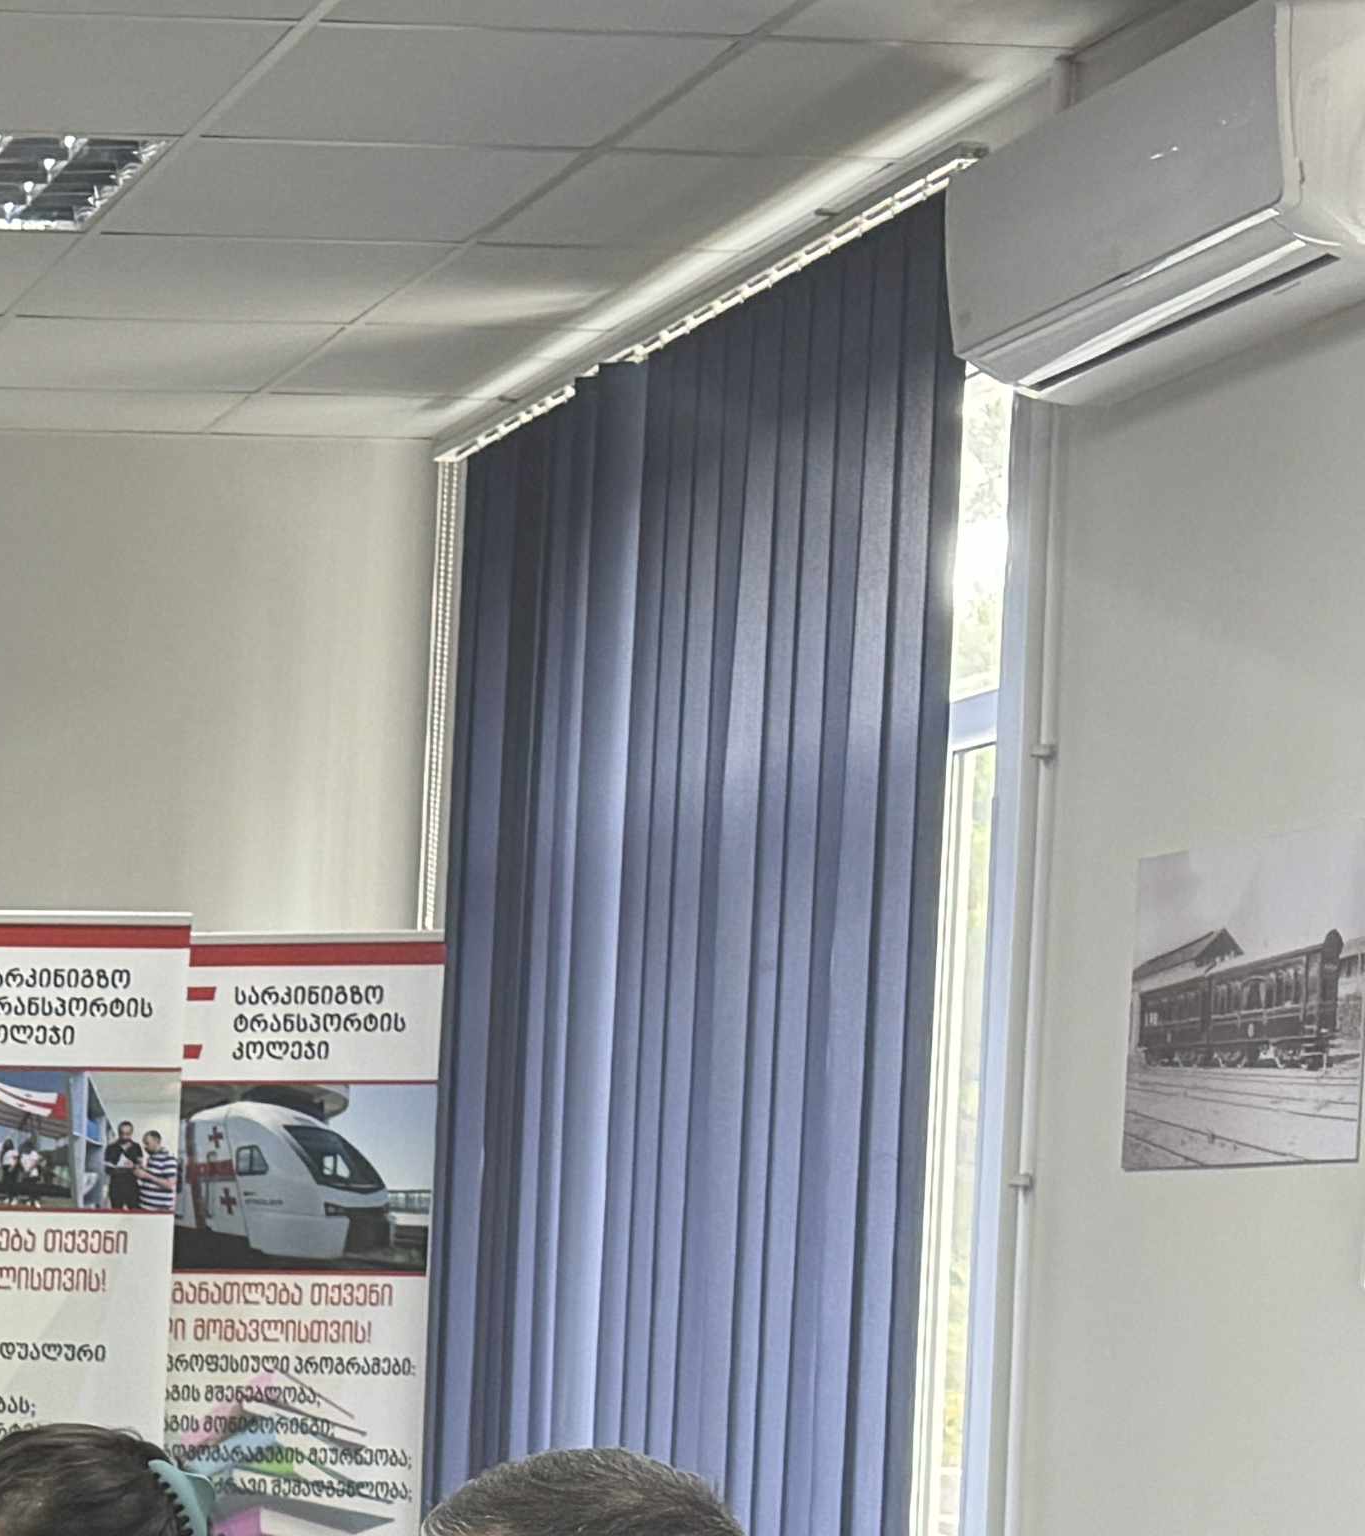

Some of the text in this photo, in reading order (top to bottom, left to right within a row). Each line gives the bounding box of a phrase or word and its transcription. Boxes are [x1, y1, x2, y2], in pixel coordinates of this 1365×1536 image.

[234, 984, 385, 1006] სარკინიგზო
[232, 1011, 407, 1034] ტრანსპორტის
[231, 1039, 330, 1061] კოლეჯი
[43, 1227, 129, 1255] თქვენი
[170, 1280, 394, 1308] განათლება თქვენი
[192, 1317, 373, 1345] მომავლისთვის!
